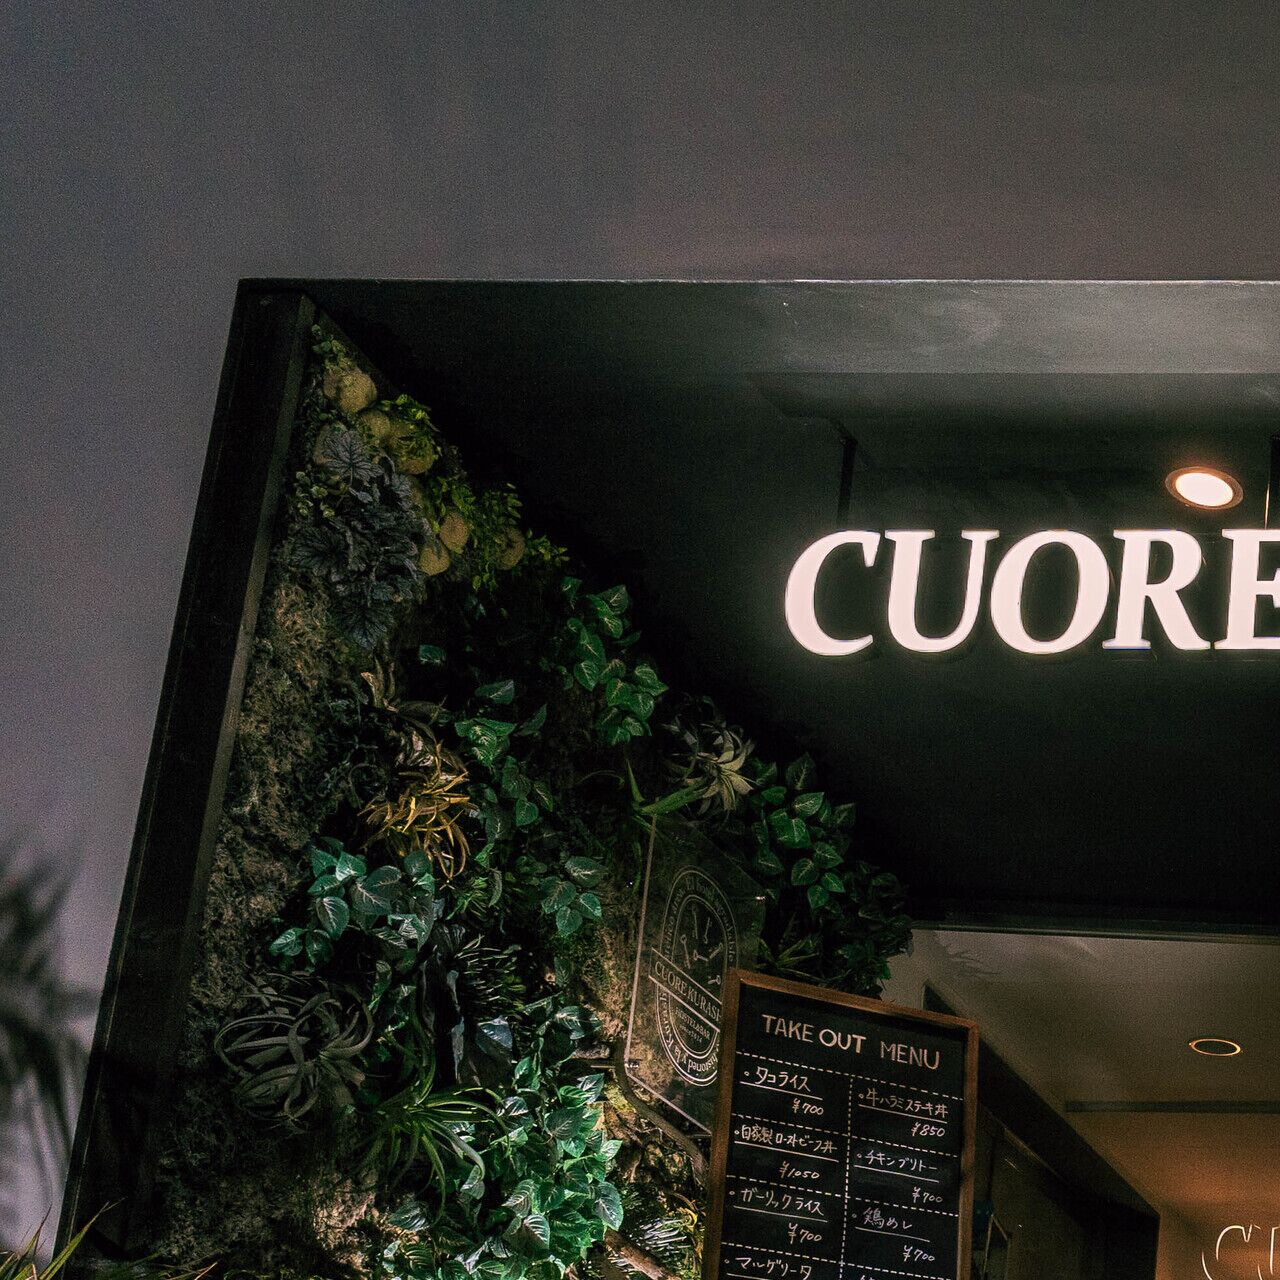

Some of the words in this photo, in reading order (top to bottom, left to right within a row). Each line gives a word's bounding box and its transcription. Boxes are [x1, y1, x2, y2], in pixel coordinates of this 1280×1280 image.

[654, 960, 688, 1000] CUORE
[762, 1014, 814, 1043] TAKE
[819, 1029, 867, 1053] OUT
[880, 1041, 940, 1070] MENU
[755, 1066, 811, 1092] タコライス
[792, 1099, 824, 1115] ¥700
[866, 1088, 948, 1118] 牛ハラミステーキ丼
[912, 1122, 945, 1137] ¥850
[865, 1149, 938, 1172] チキンブリトー
[912, 1186, 943, 1204] ¥700
[863, 1207, 913, 1229] 鶏めし
[788, 1222, 823, 1244] ¥700
[903, 1244, 935, 1262] ¥700
[735, 1257, 812, 1280] マルゲリータ
